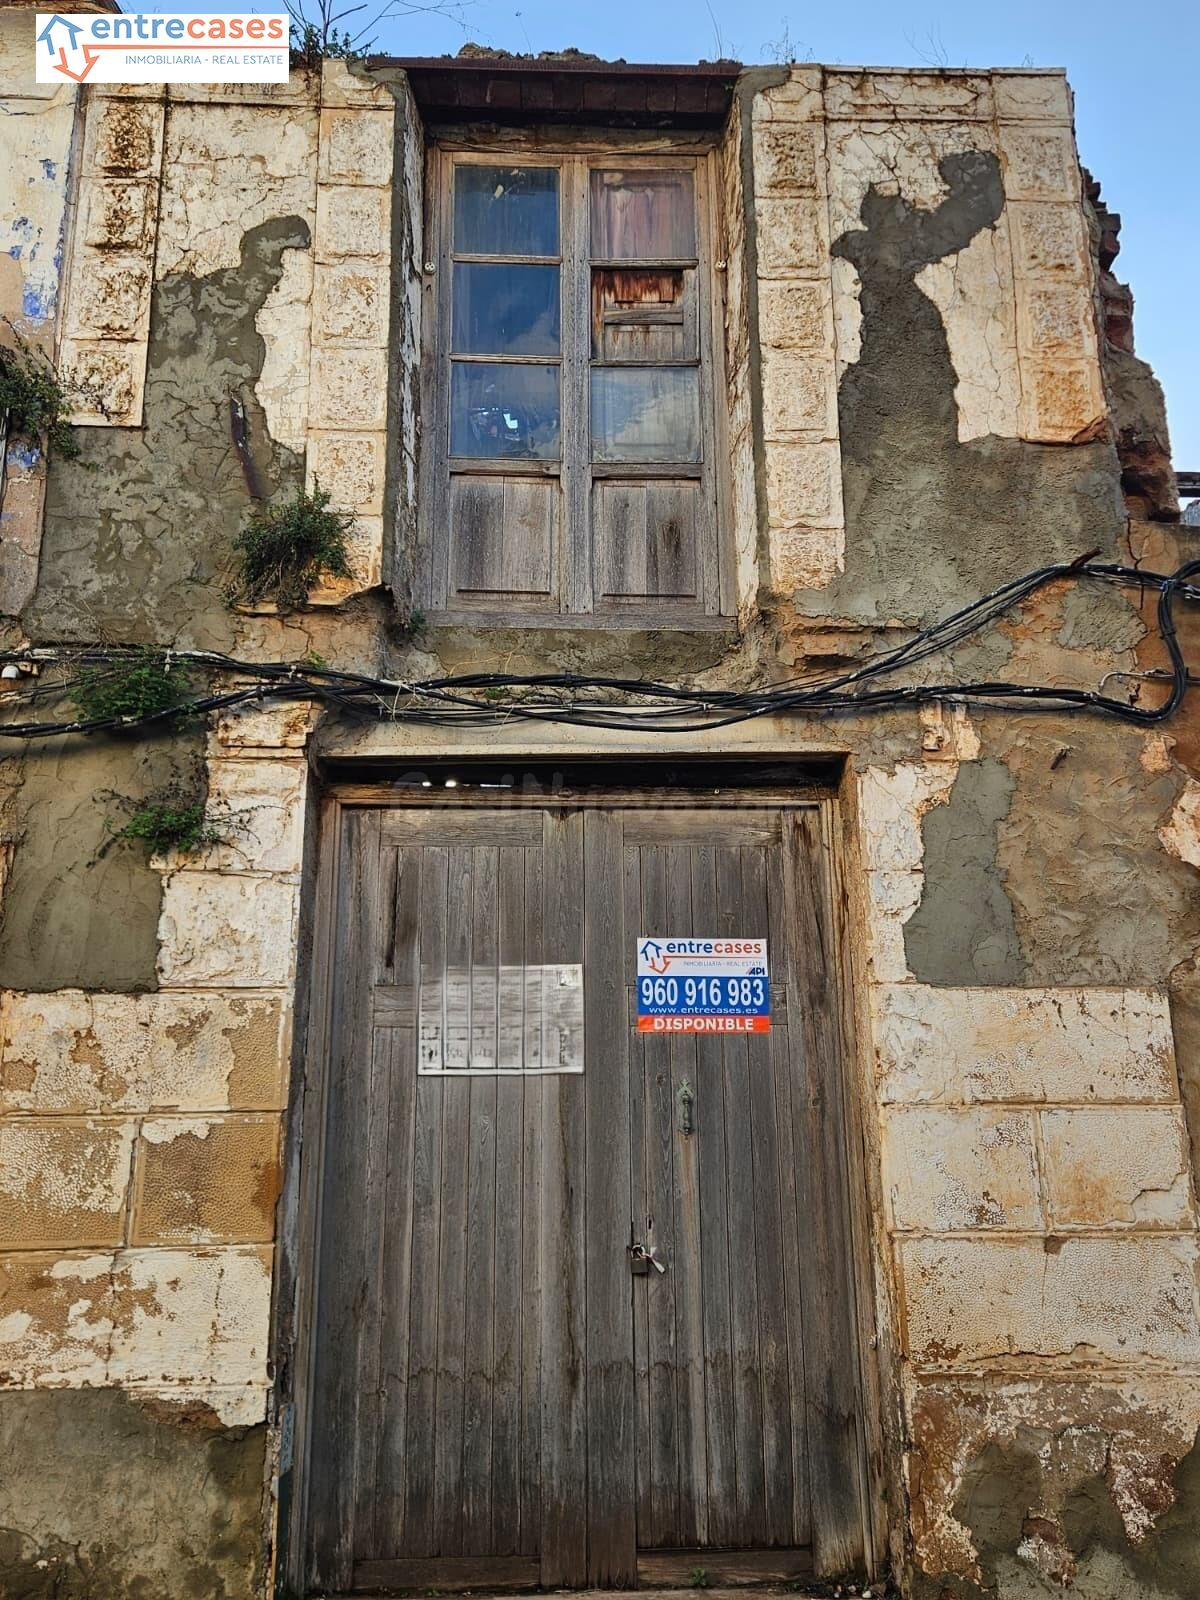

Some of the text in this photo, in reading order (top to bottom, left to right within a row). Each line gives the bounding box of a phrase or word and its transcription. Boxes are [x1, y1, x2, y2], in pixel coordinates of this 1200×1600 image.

[666, 940, 762, 954] entrecases
[642, 978, 764, 1006] 960 916 983
[649, 1006, 759, 1014] www.entrecases.es
[653, 1018, 754, 1031] DISPONIBLE
